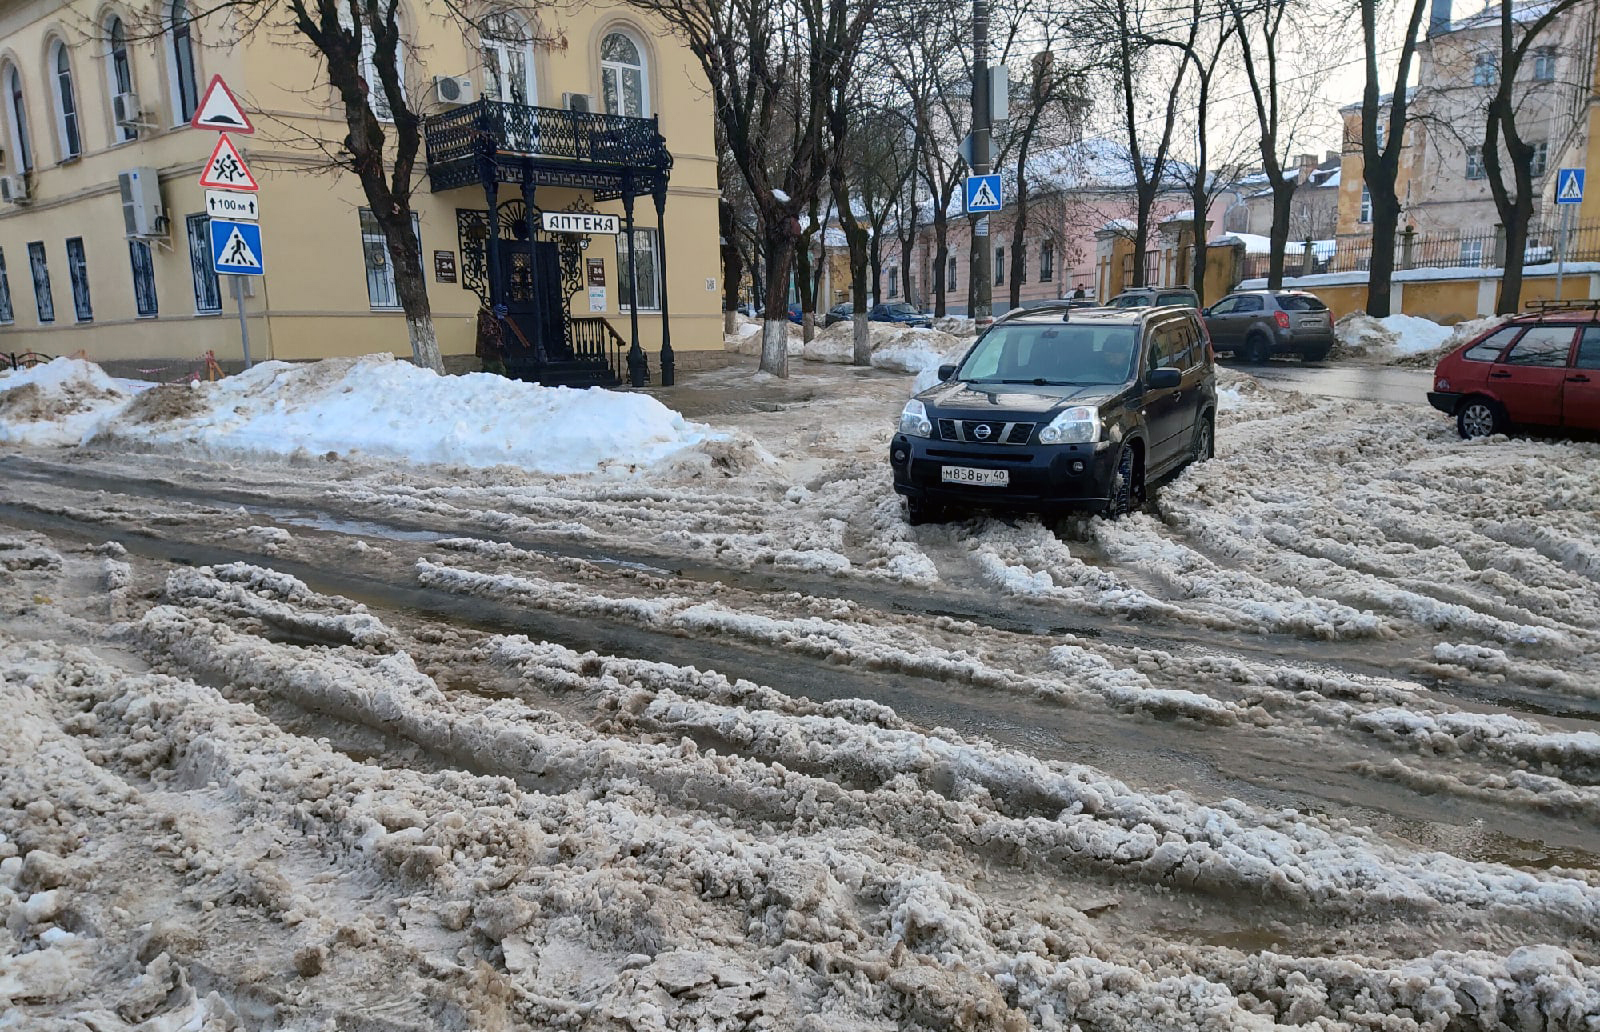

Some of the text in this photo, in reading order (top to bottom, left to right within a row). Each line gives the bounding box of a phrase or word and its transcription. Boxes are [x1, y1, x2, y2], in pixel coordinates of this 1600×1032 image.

[218, 199, 236, 210] 100
[549, 215, 614, 231] АПТЕКА
[993, 470, 1005, 480] 40
